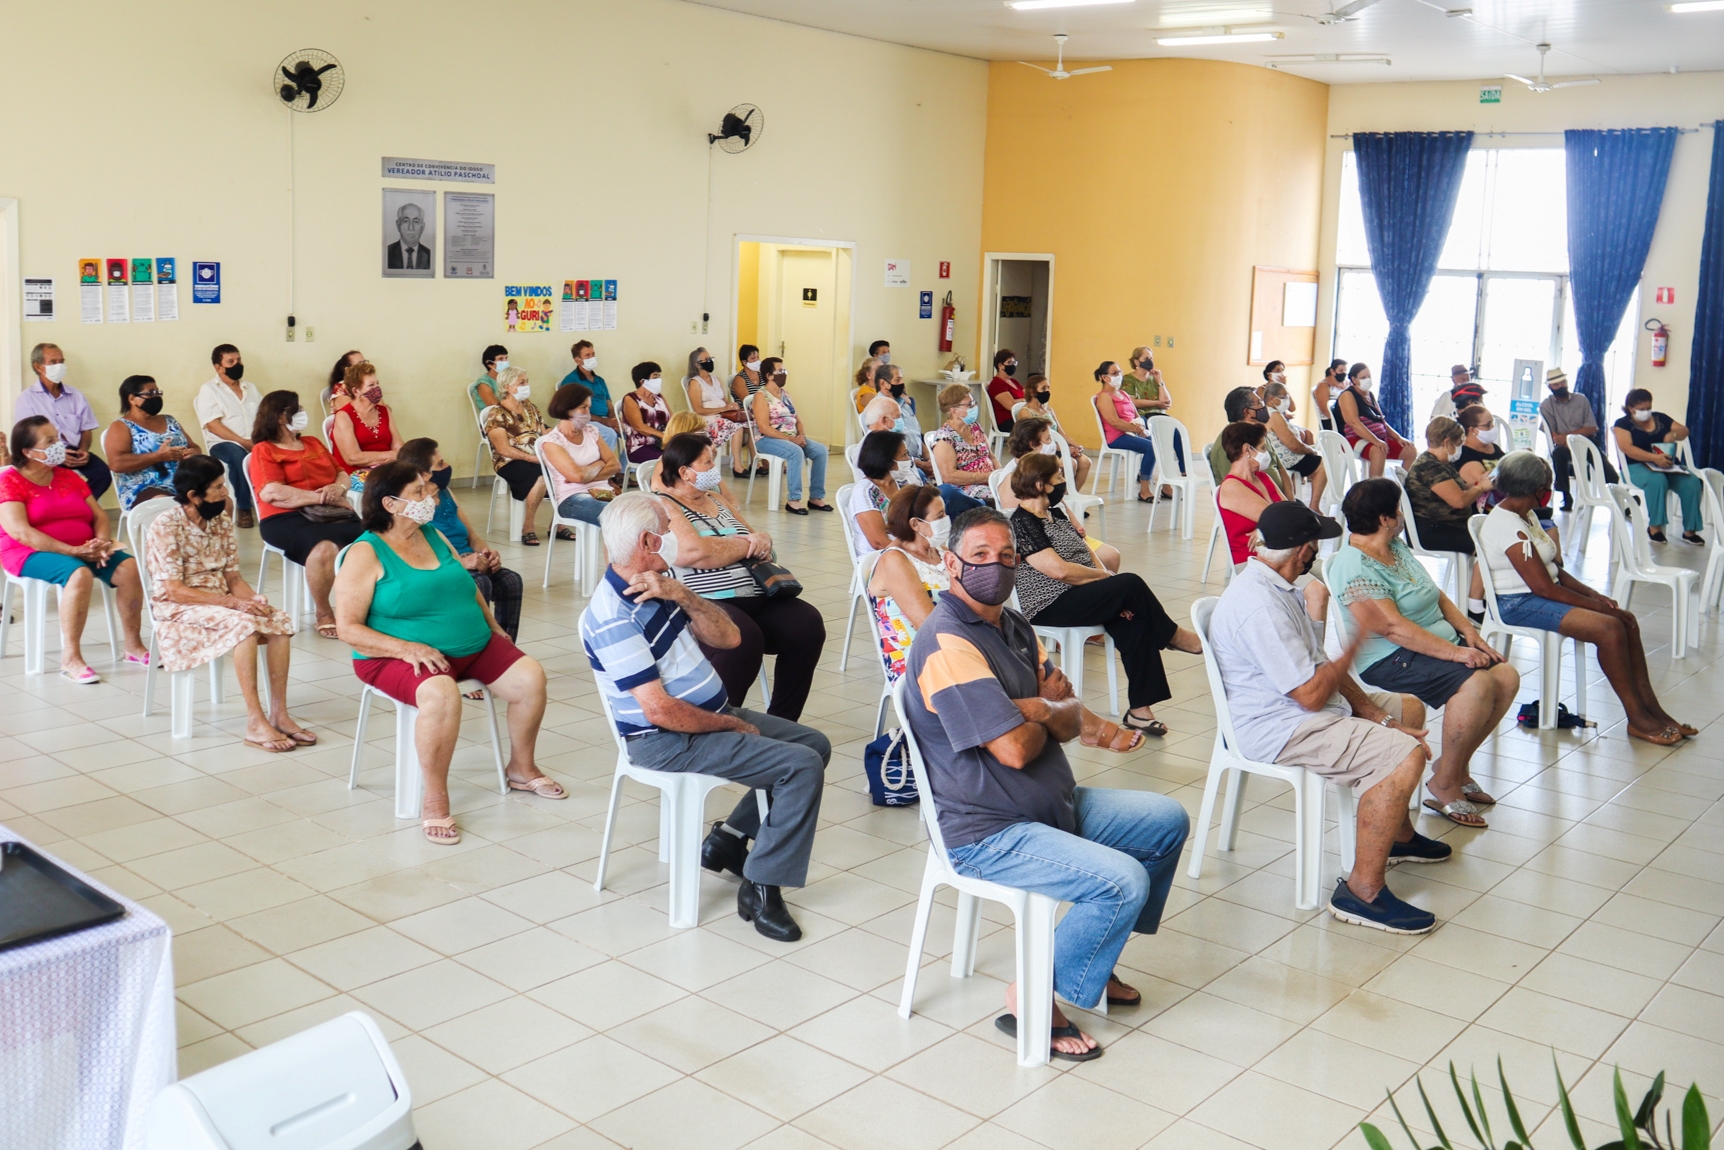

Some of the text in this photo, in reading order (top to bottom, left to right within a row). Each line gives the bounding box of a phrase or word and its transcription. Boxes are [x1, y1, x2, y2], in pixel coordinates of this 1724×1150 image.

[1480, 89, 1501, 100] SAÍDA
[424, 163, 458, 171] CONVIVÊNCIA
[387, 167, 426, 176] VEREADOR
[453, 171, 491, 180] PASCHOAL
[505, 285, 552, 296] BEM VINDOS
[524, 298, 535, 309] AO
[520, 309, 540, 321] GURI
